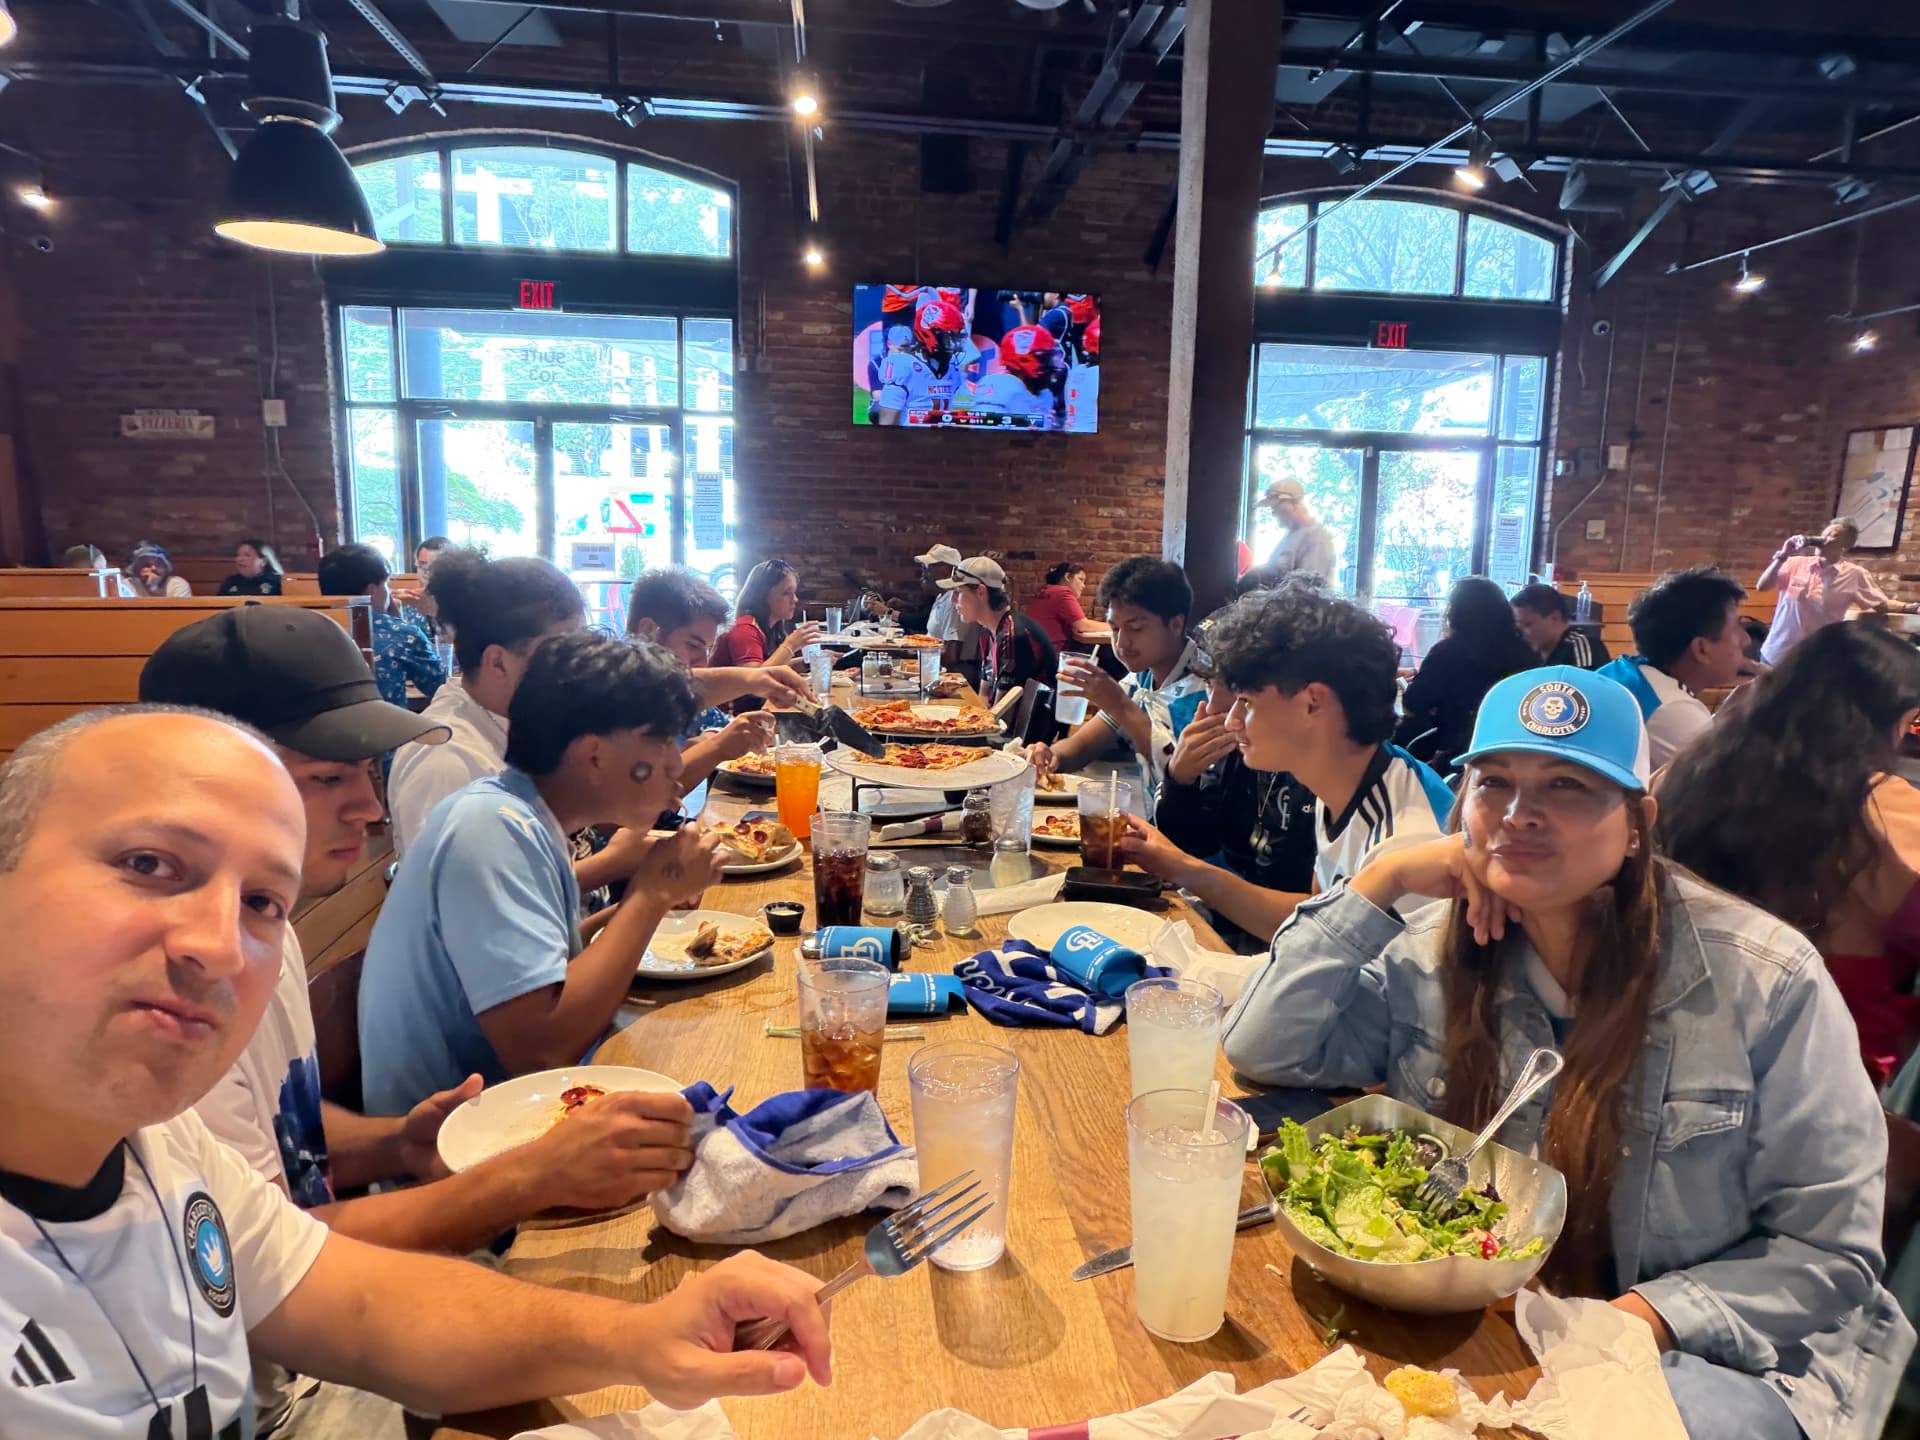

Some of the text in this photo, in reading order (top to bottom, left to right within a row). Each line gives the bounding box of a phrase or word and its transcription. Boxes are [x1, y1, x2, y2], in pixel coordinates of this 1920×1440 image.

[520, 281, 554, 309] EXIT
[1378, 322, 1407, 348] EXIT
[1539, 683, 1576, 696] SOUTH
[1526, 720, 1577, 734] CHARLOTTE
